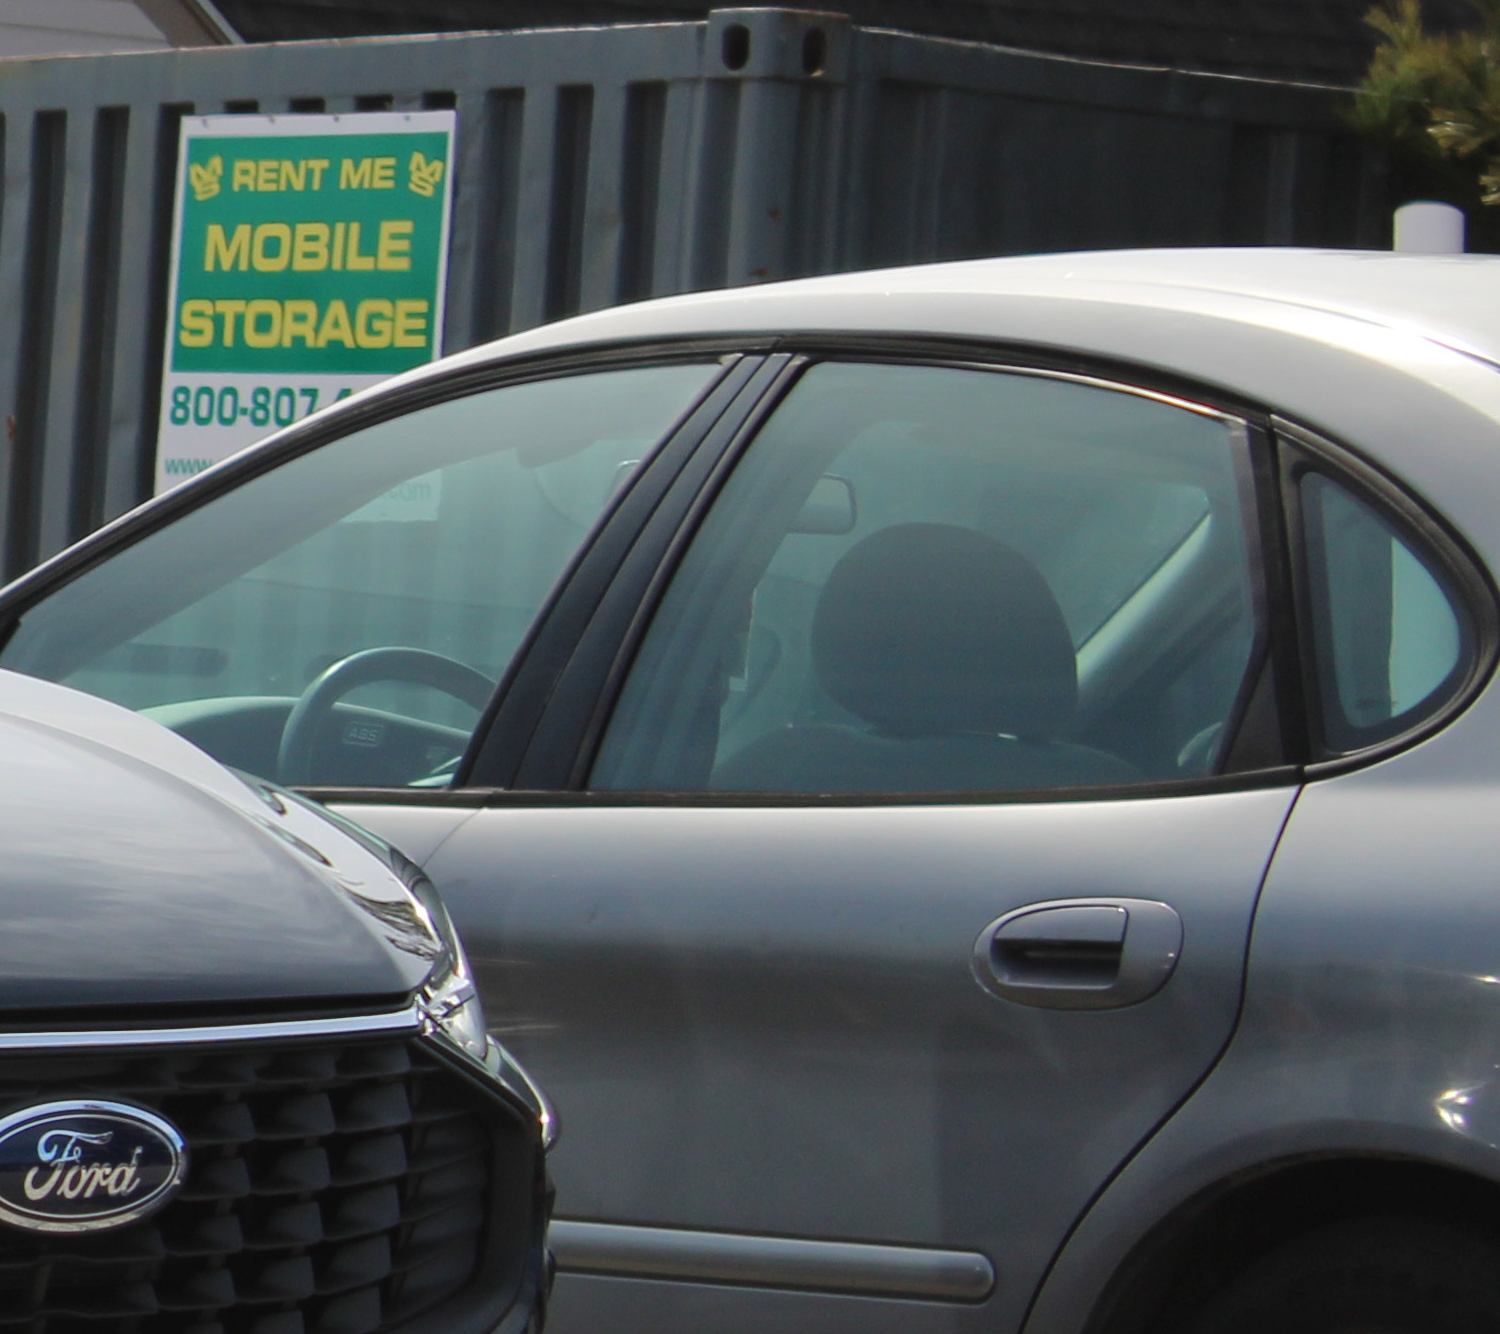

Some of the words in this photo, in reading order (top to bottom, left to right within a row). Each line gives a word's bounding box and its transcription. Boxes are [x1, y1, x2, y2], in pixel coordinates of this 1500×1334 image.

[232, 158, 330, 192] RENT
[339, 157, 397, 190] ME
[204, 220, 414, 272] MOBILE
[179, 298, 429, 348] STORAGE
[23, 1129, 143, 1201] Ford
